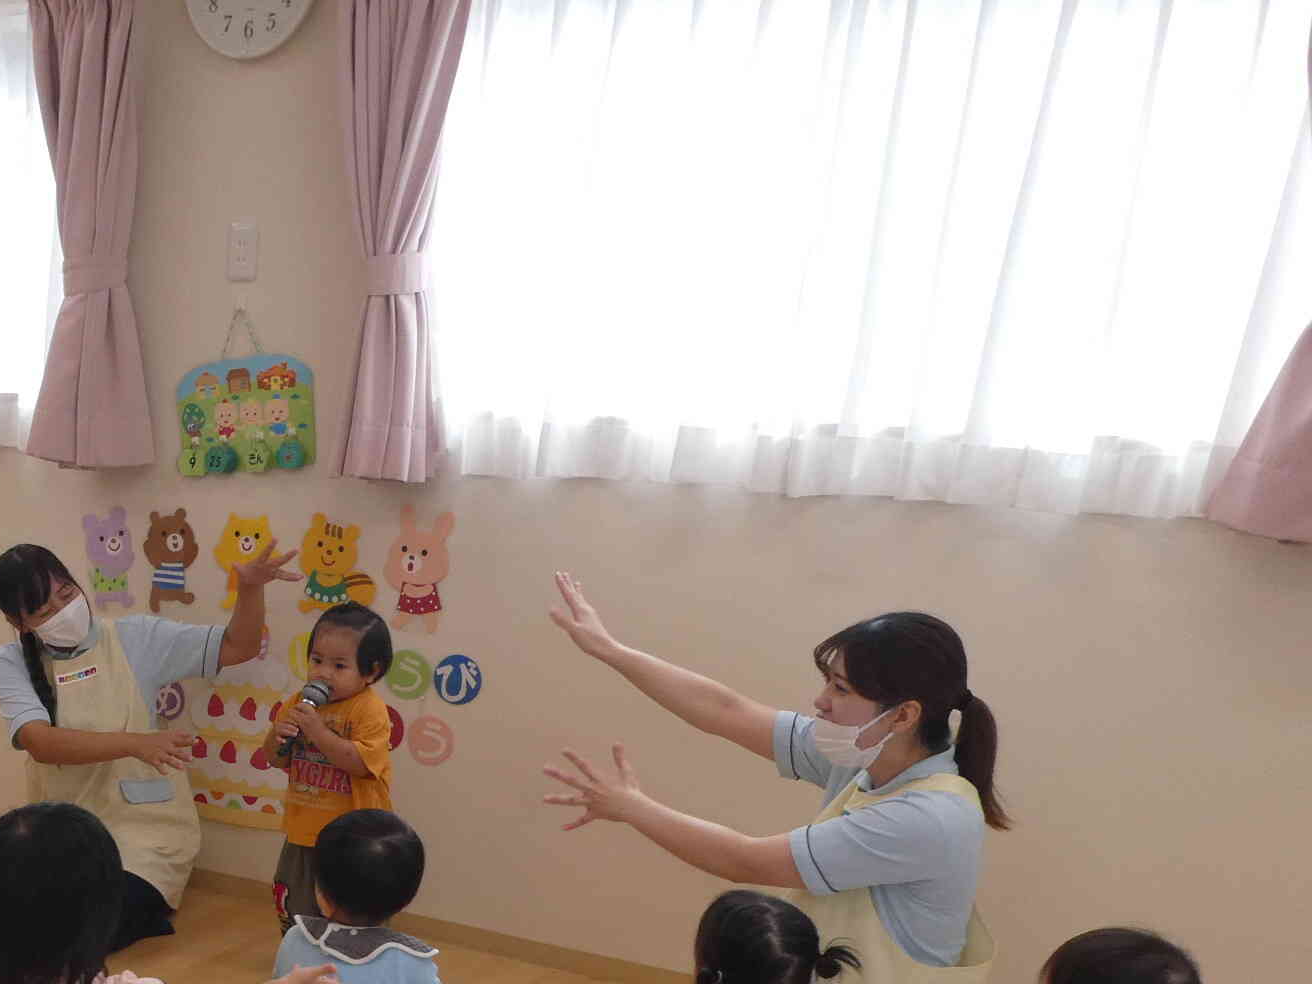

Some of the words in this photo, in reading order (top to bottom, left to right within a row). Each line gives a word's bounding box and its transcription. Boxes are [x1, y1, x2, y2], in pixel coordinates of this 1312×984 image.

[223, 15, 233, 33] 7
[243, 20, 254, 39] 6
[265, 12, 276, 32] 5
